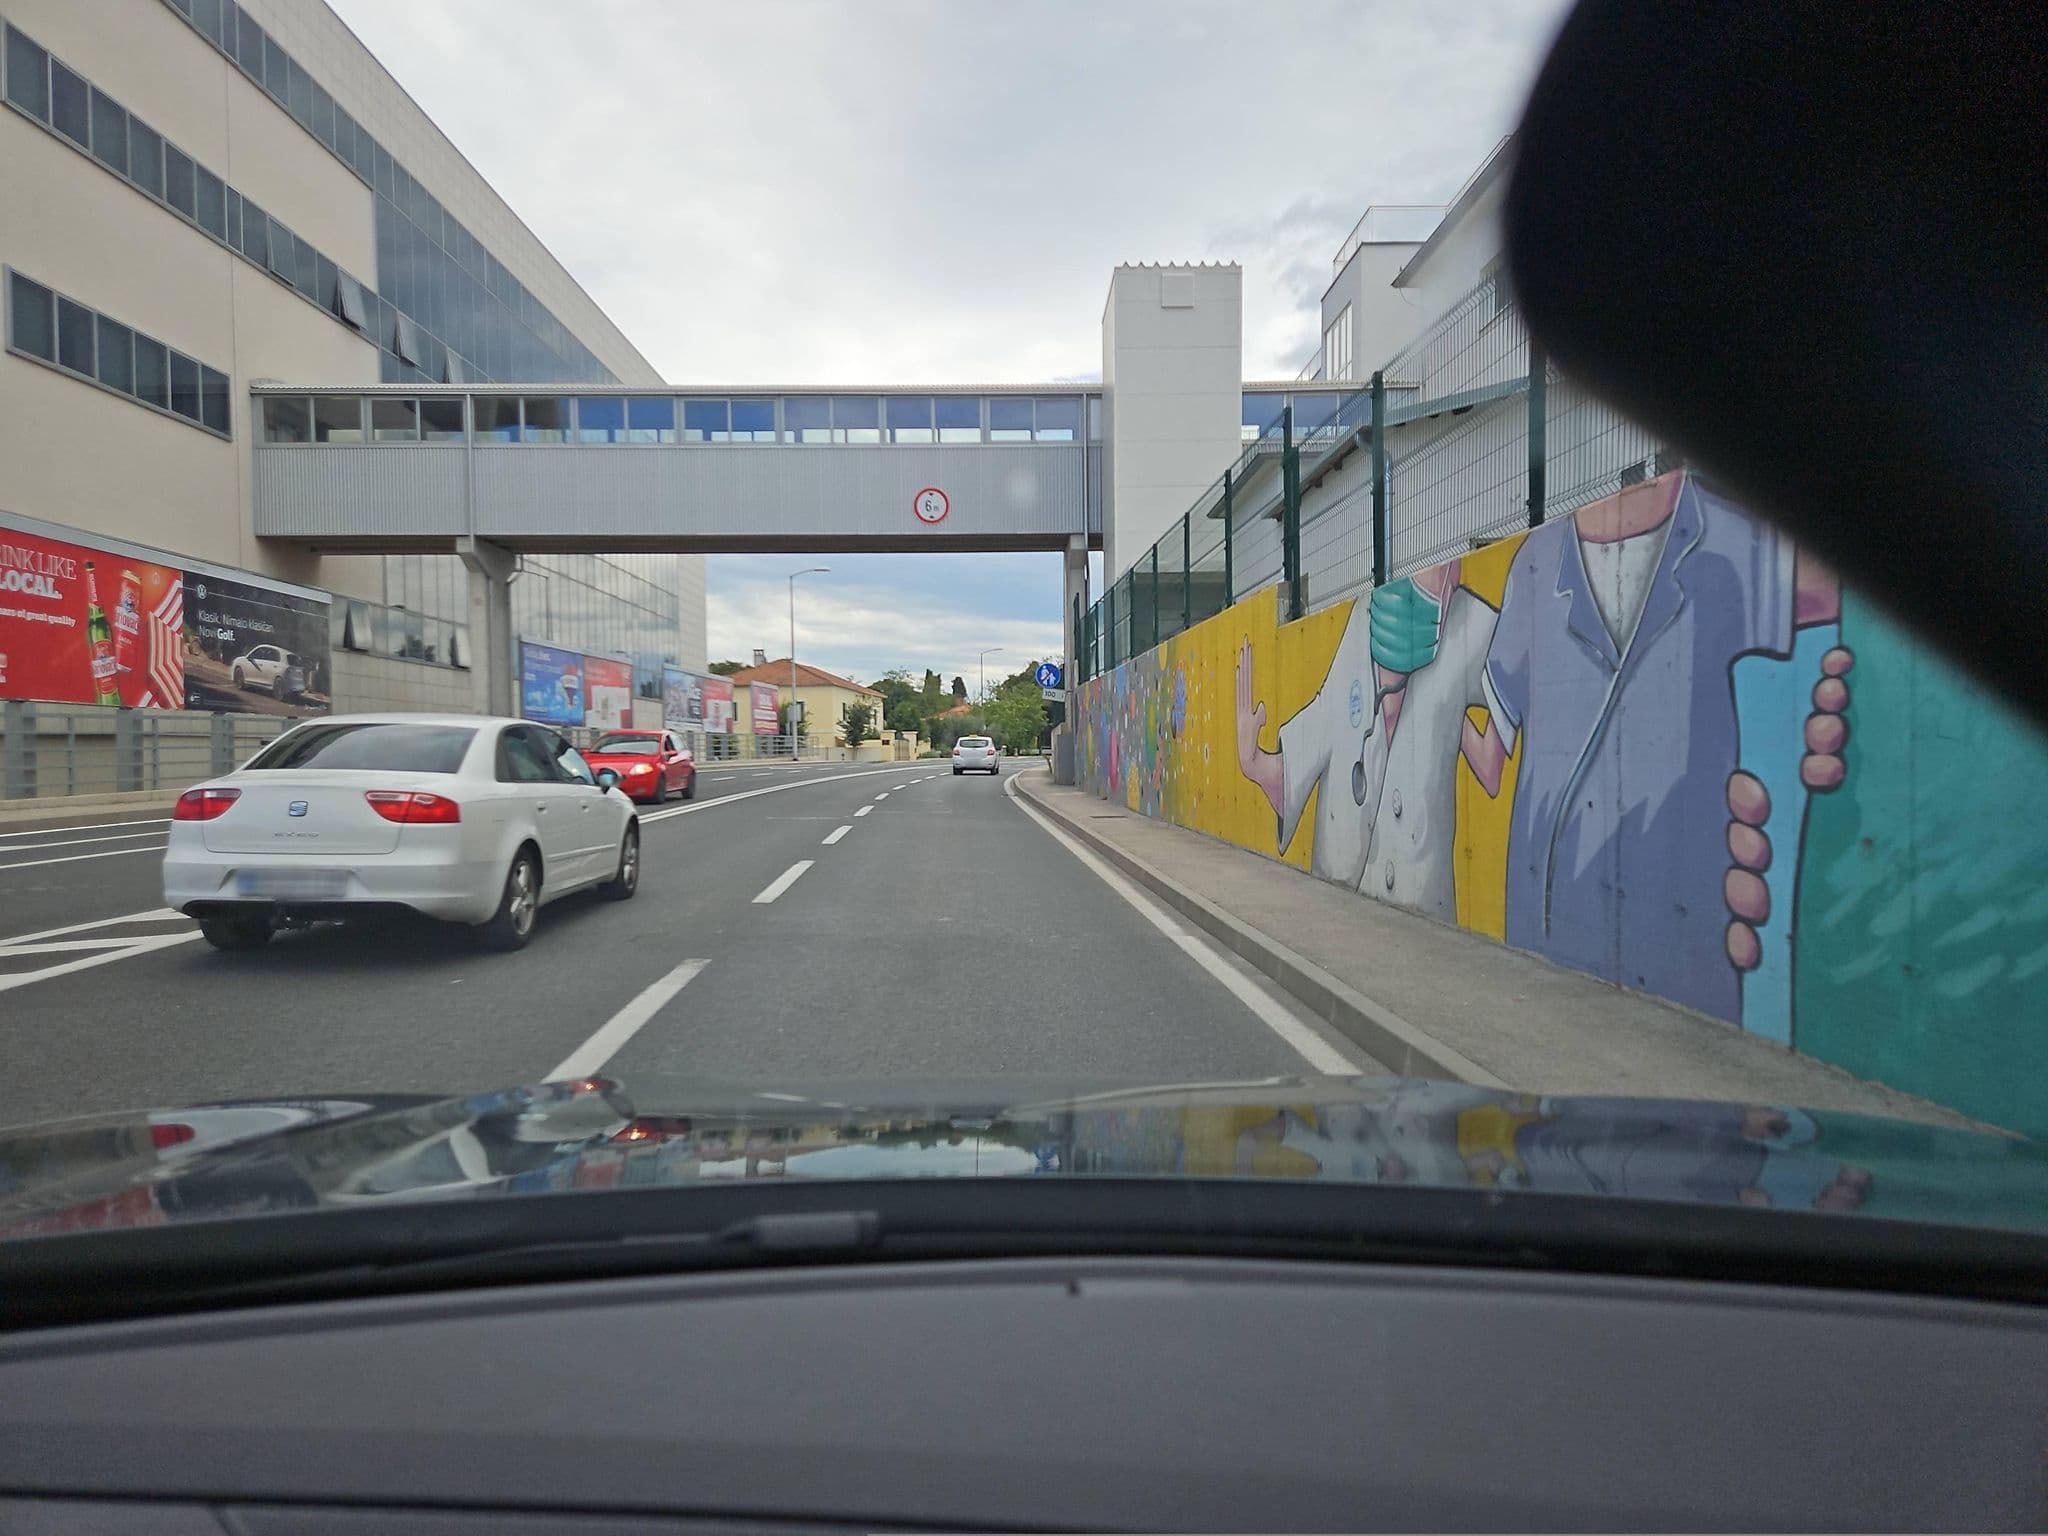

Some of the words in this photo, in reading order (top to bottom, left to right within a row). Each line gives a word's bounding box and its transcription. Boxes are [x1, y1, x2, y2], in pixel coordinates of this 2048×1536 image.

[925, 500, 932, 512] 6
[0, 544, 35, 571] INK
[37, 552, 77, 580] LIKE
[48, 615, 76, 627] quality
[217, 628, 236, 641] Golf.
